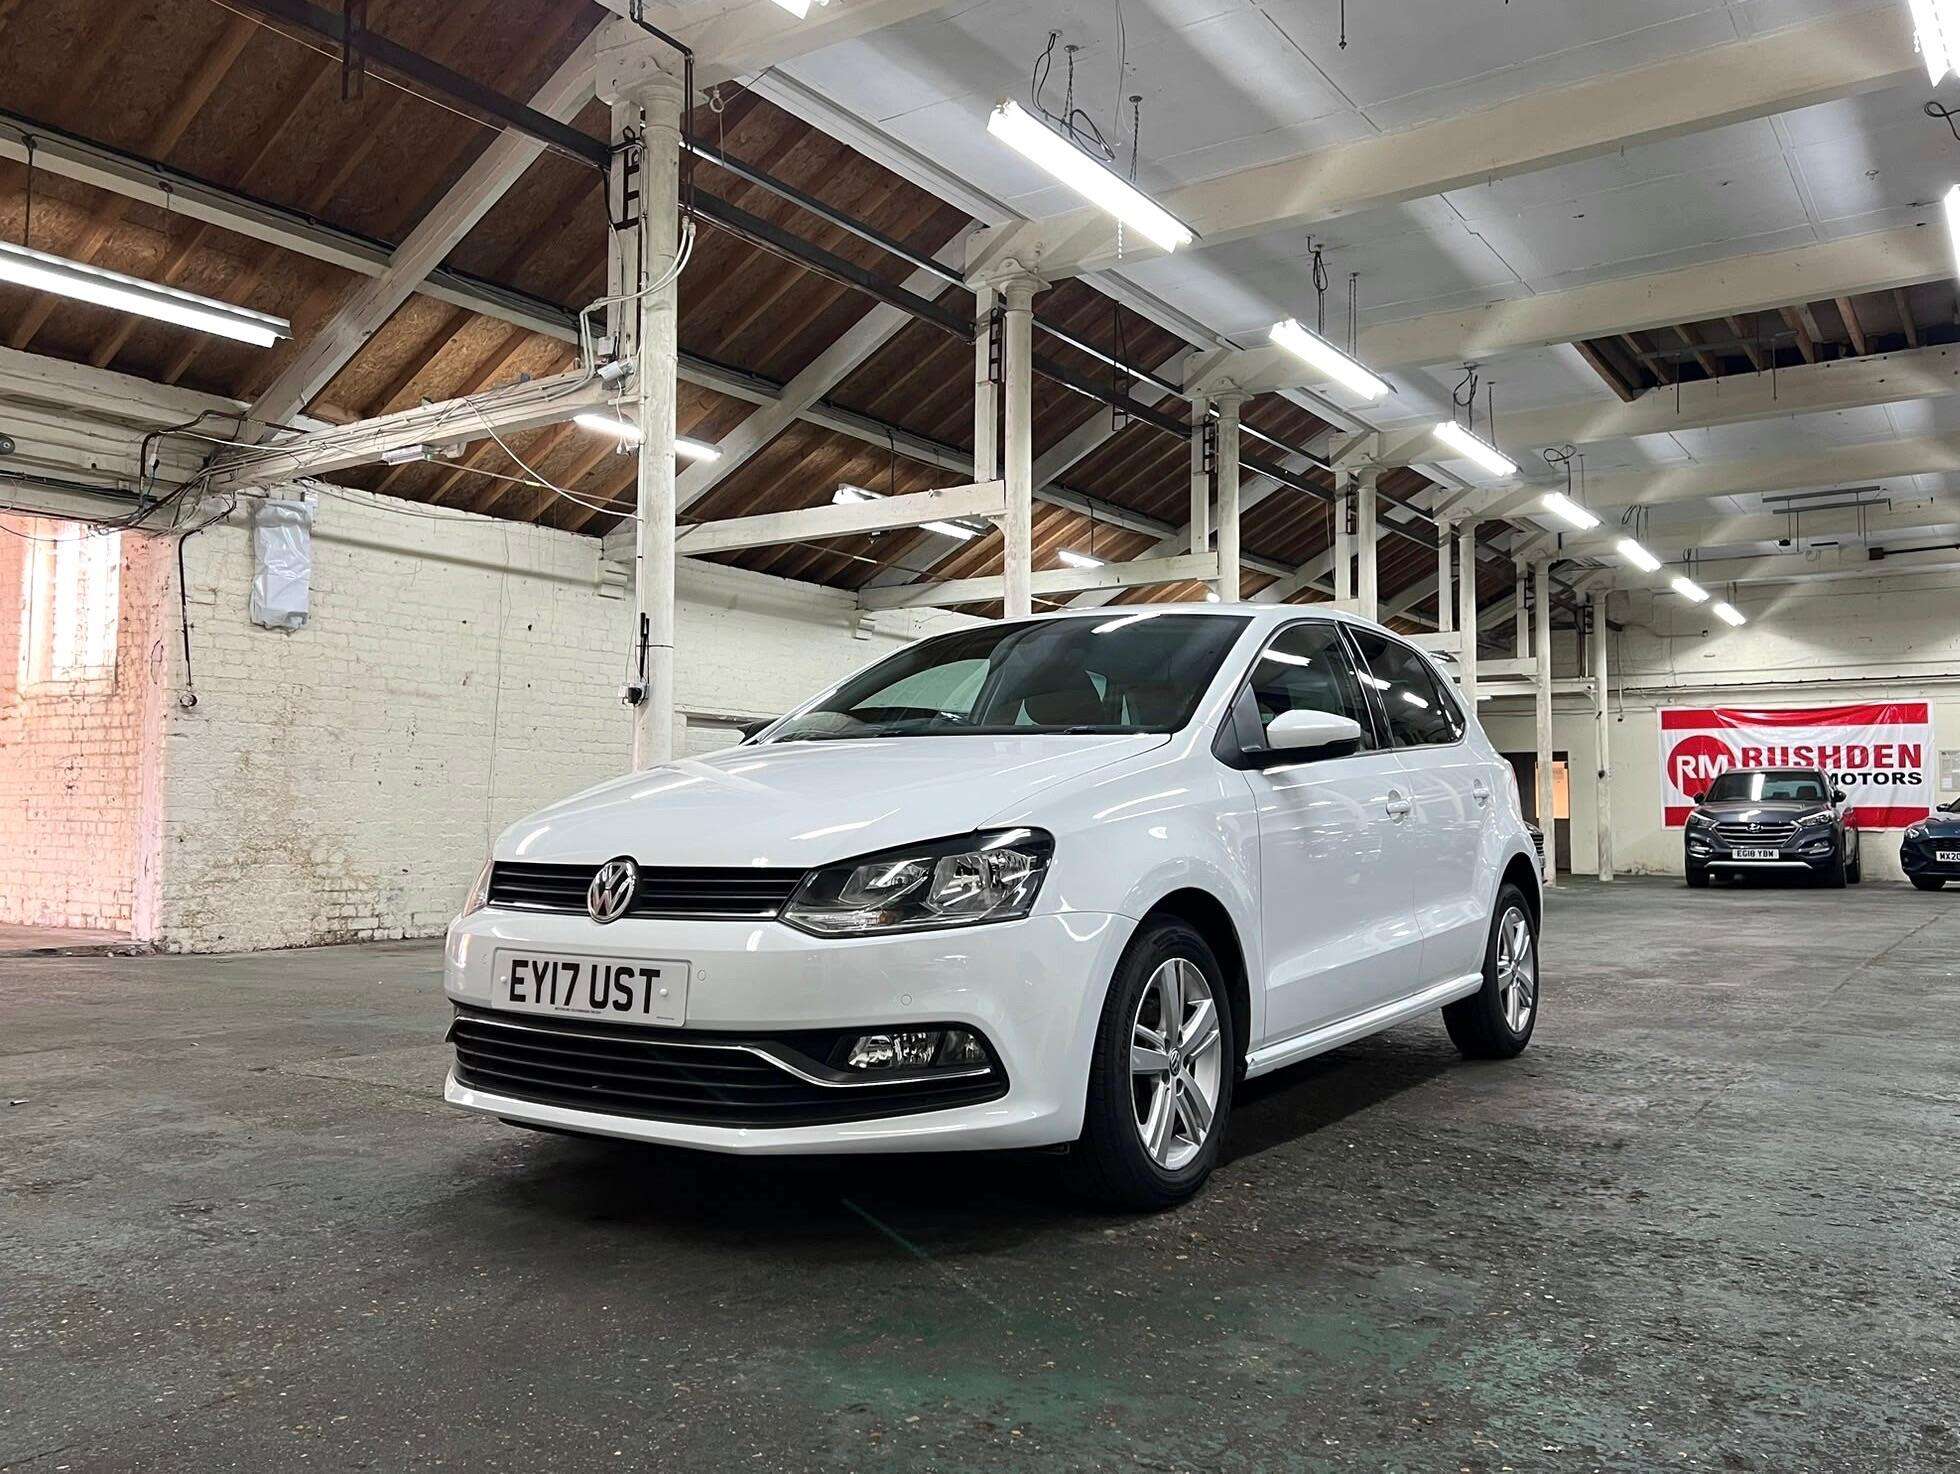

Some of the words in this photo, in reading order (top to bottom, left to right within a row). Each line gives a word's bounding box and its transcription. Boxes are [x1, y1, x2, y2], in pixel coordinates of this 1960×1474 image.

[1676, 754, 1729, 790] RM
[1741, 743, 1922, 769] RUSHDEN
[509, 959, 580, 1006] EY17
[589, 964, 661, 1014] UST
